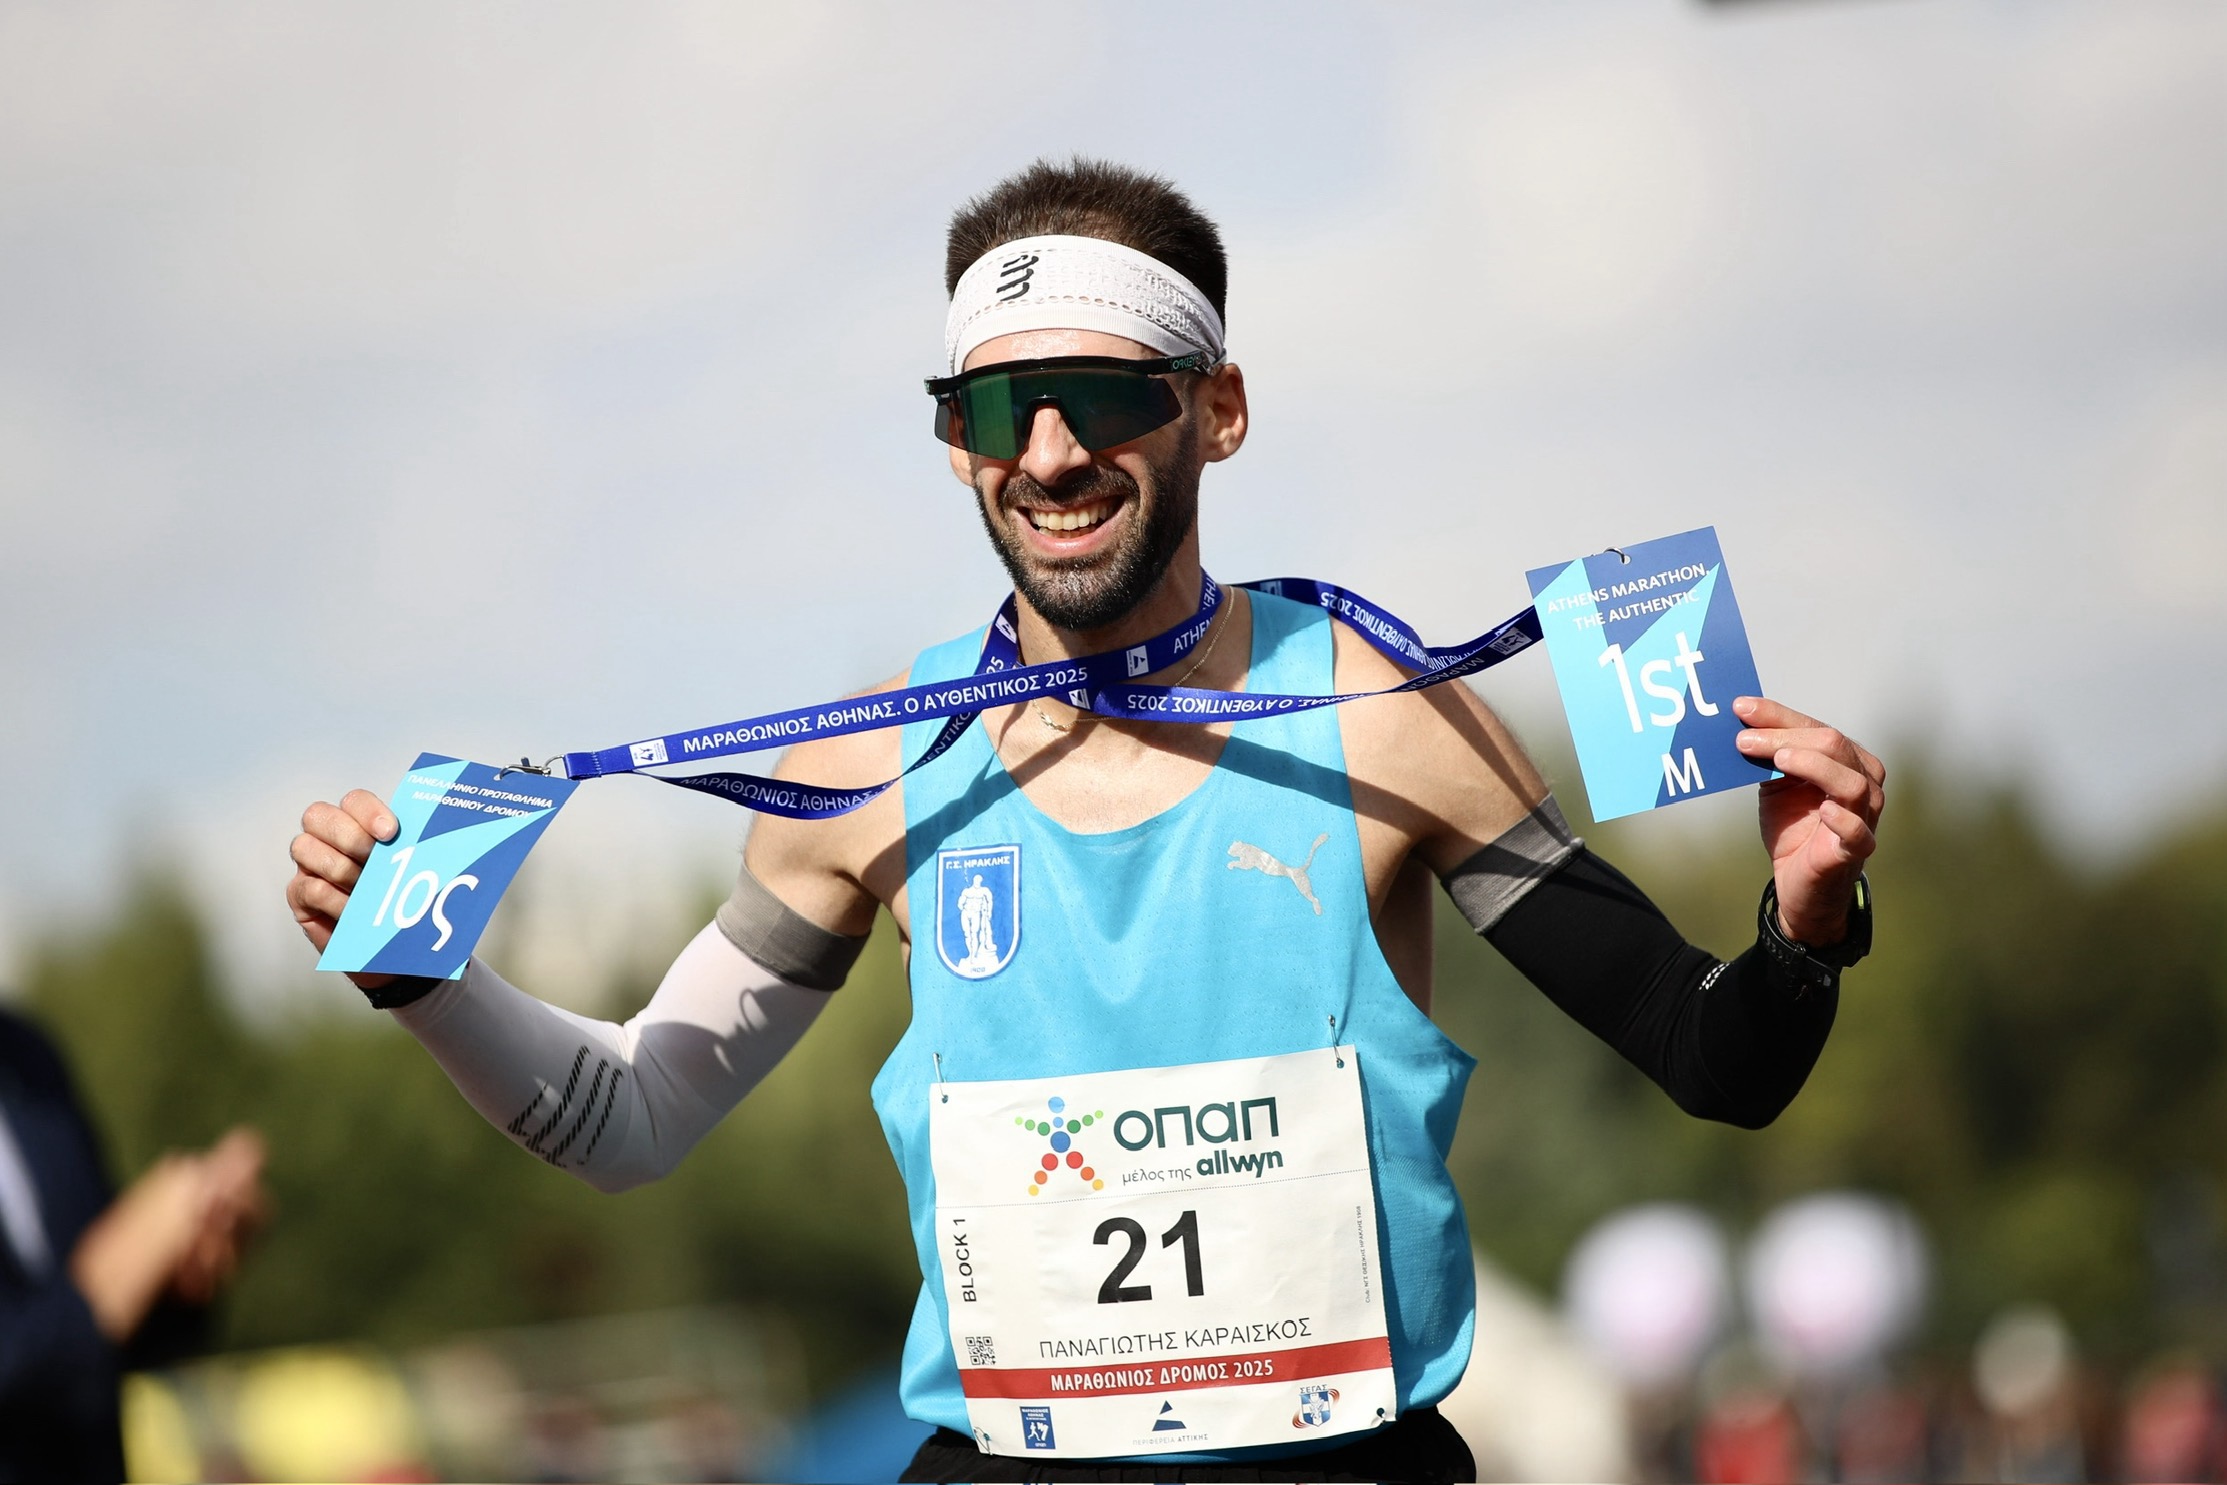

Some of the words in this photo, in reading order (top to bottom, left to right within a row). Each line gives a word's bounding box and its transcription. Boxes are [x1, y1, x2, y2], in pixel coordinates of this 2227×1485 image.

[1320, 592, 1353, 616] 2025
[1548, 588, 1609, 614] ATHENS
[1573, 612, 1606, 632] THE
[1609, 589, 1700, 623] AUTHENTIC
[1597, 631, 1720, 734] 1st
[683, 716, 813, 753] ΜΑΡΑΘΩΝΙΟΣ
[816, 701, 902, 730] ΑΘΗΝΑΣ.
[923, 674, 1041, 711] ΑΥΘΕΝΤΙΚΟΣ
[1045, 667, 1088, 688] 2025
[1127, 694, 1167, 712] 2025
[1171, 696, 1273, 714] ΑΥΘΕΝΤΙΚΟΣ
[407, 774, 479, 795] ΠΑΝΕΛΛΗΝΙΟ
[478, 788, 553, 809] ΠΡΩΤΑΘΛΗΜΑ
[680, 778, 798, 809] ΜΑΡΑΘΩΝΙΟΣ
[964, 856, 1011, 869] ΗΡΑΚΛΗΣ
[372, 846, 480, 952] 1ος
[1122, 1168, 1166, 1186] μέλος
[1168, 1168, 1192, 1181] της
[1196, 1148, 1284, 1179] allwyn
[953, 1233, 977, 1302] BLOCK
[1093, 1210, 1204, 1304] 21
[1040, 1332, 1178, 1358] ΠΑΝΑΓΙΩΤΗΣ
[1185, 1317, 1312, 1348] ΚΑΡΑΙΣΚΟΣ
[1050, 1369, 1155, 1391] ΜΑΡΑΘΩΝΙΟΣ
[1160, 1362, 1229, 1384] ΔΡΟΜΟΣ
[1233, 1360, 1274, 1378] 2025
[1299, 1384, 1328, 1393] ΣΕΓΑΣ
[1178, 1434, 1209, 1442] ΑΤΤΙΚΗΣ
